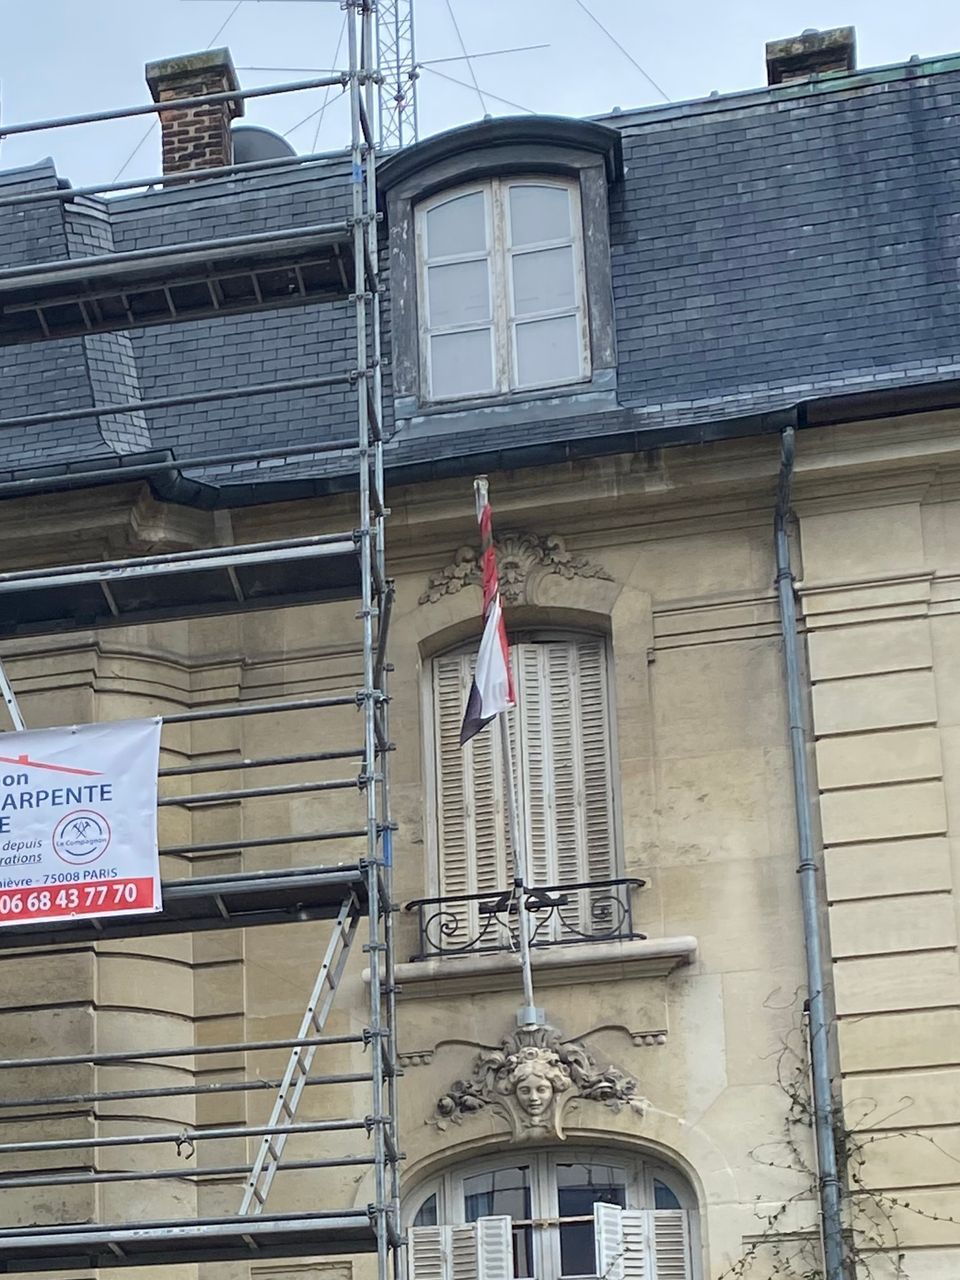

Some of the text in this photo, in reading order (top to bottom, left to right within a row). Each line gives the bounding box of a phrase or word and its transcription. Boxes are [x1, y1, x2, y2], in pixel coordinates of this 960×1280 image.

[2, 839, 42, 854] depuis
[43, 871, 80, 885] 75008
[83, 867, 118, 881] PARIS
[0, 894, 23, 914] 06
[27, 891, 51, 911] 68
[55, 888, 79, 908] 43
[84, 885, 107, 905] 77
[113, 883, 137, 903] 70
